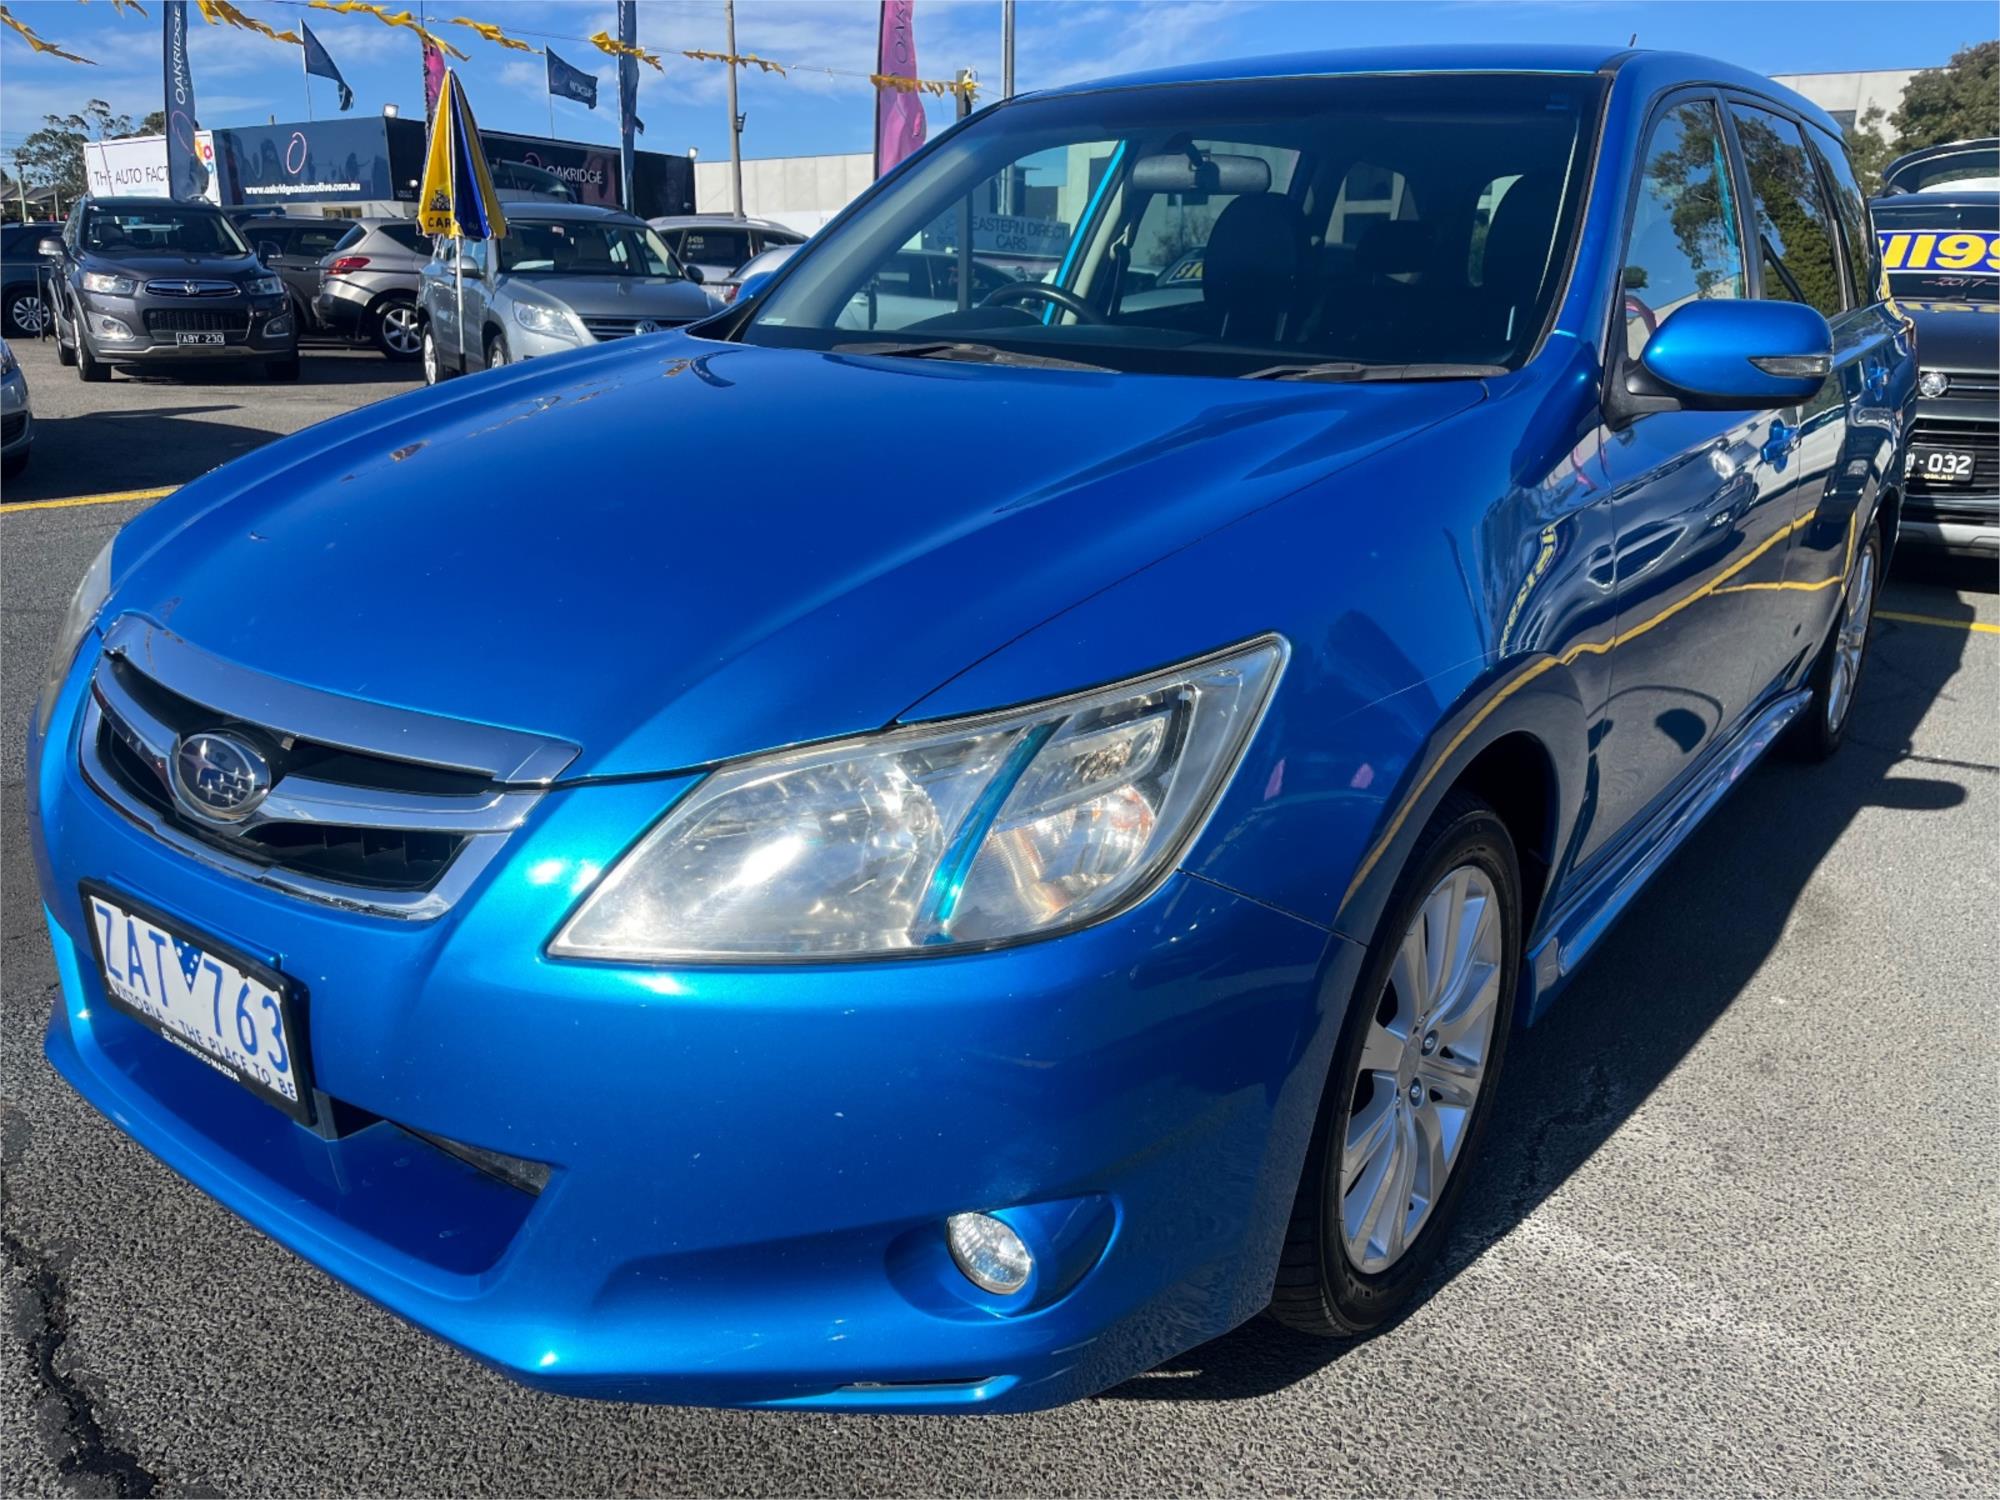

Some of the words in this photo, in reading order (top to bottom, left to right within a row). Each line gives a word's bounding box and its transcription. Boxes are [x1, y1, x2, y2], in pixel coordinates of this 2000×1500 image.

[173, 4, 186, 105] OAKRIDGE
[116, 168, 142, 184] AUTO
[145, 165, 169, 182] FACT
[545, 165, 603, 184] OAKRIDGE
[245, 182, 361, 195] www.oakridgeautomotive.com.au
[996, 234, 1028, 251] CARS
[95, 903, 169, 1008] ZAT
[203, 959, 288, 1074] 763
[111, 979, 163, 1019] VICTORIA
[179, 1019, 204, 1046] THE
[208, 1033, 249, 1073] PLACE
[253, 1064, 271, 1086] TO
[279, 1078, 297, 1099] BE
